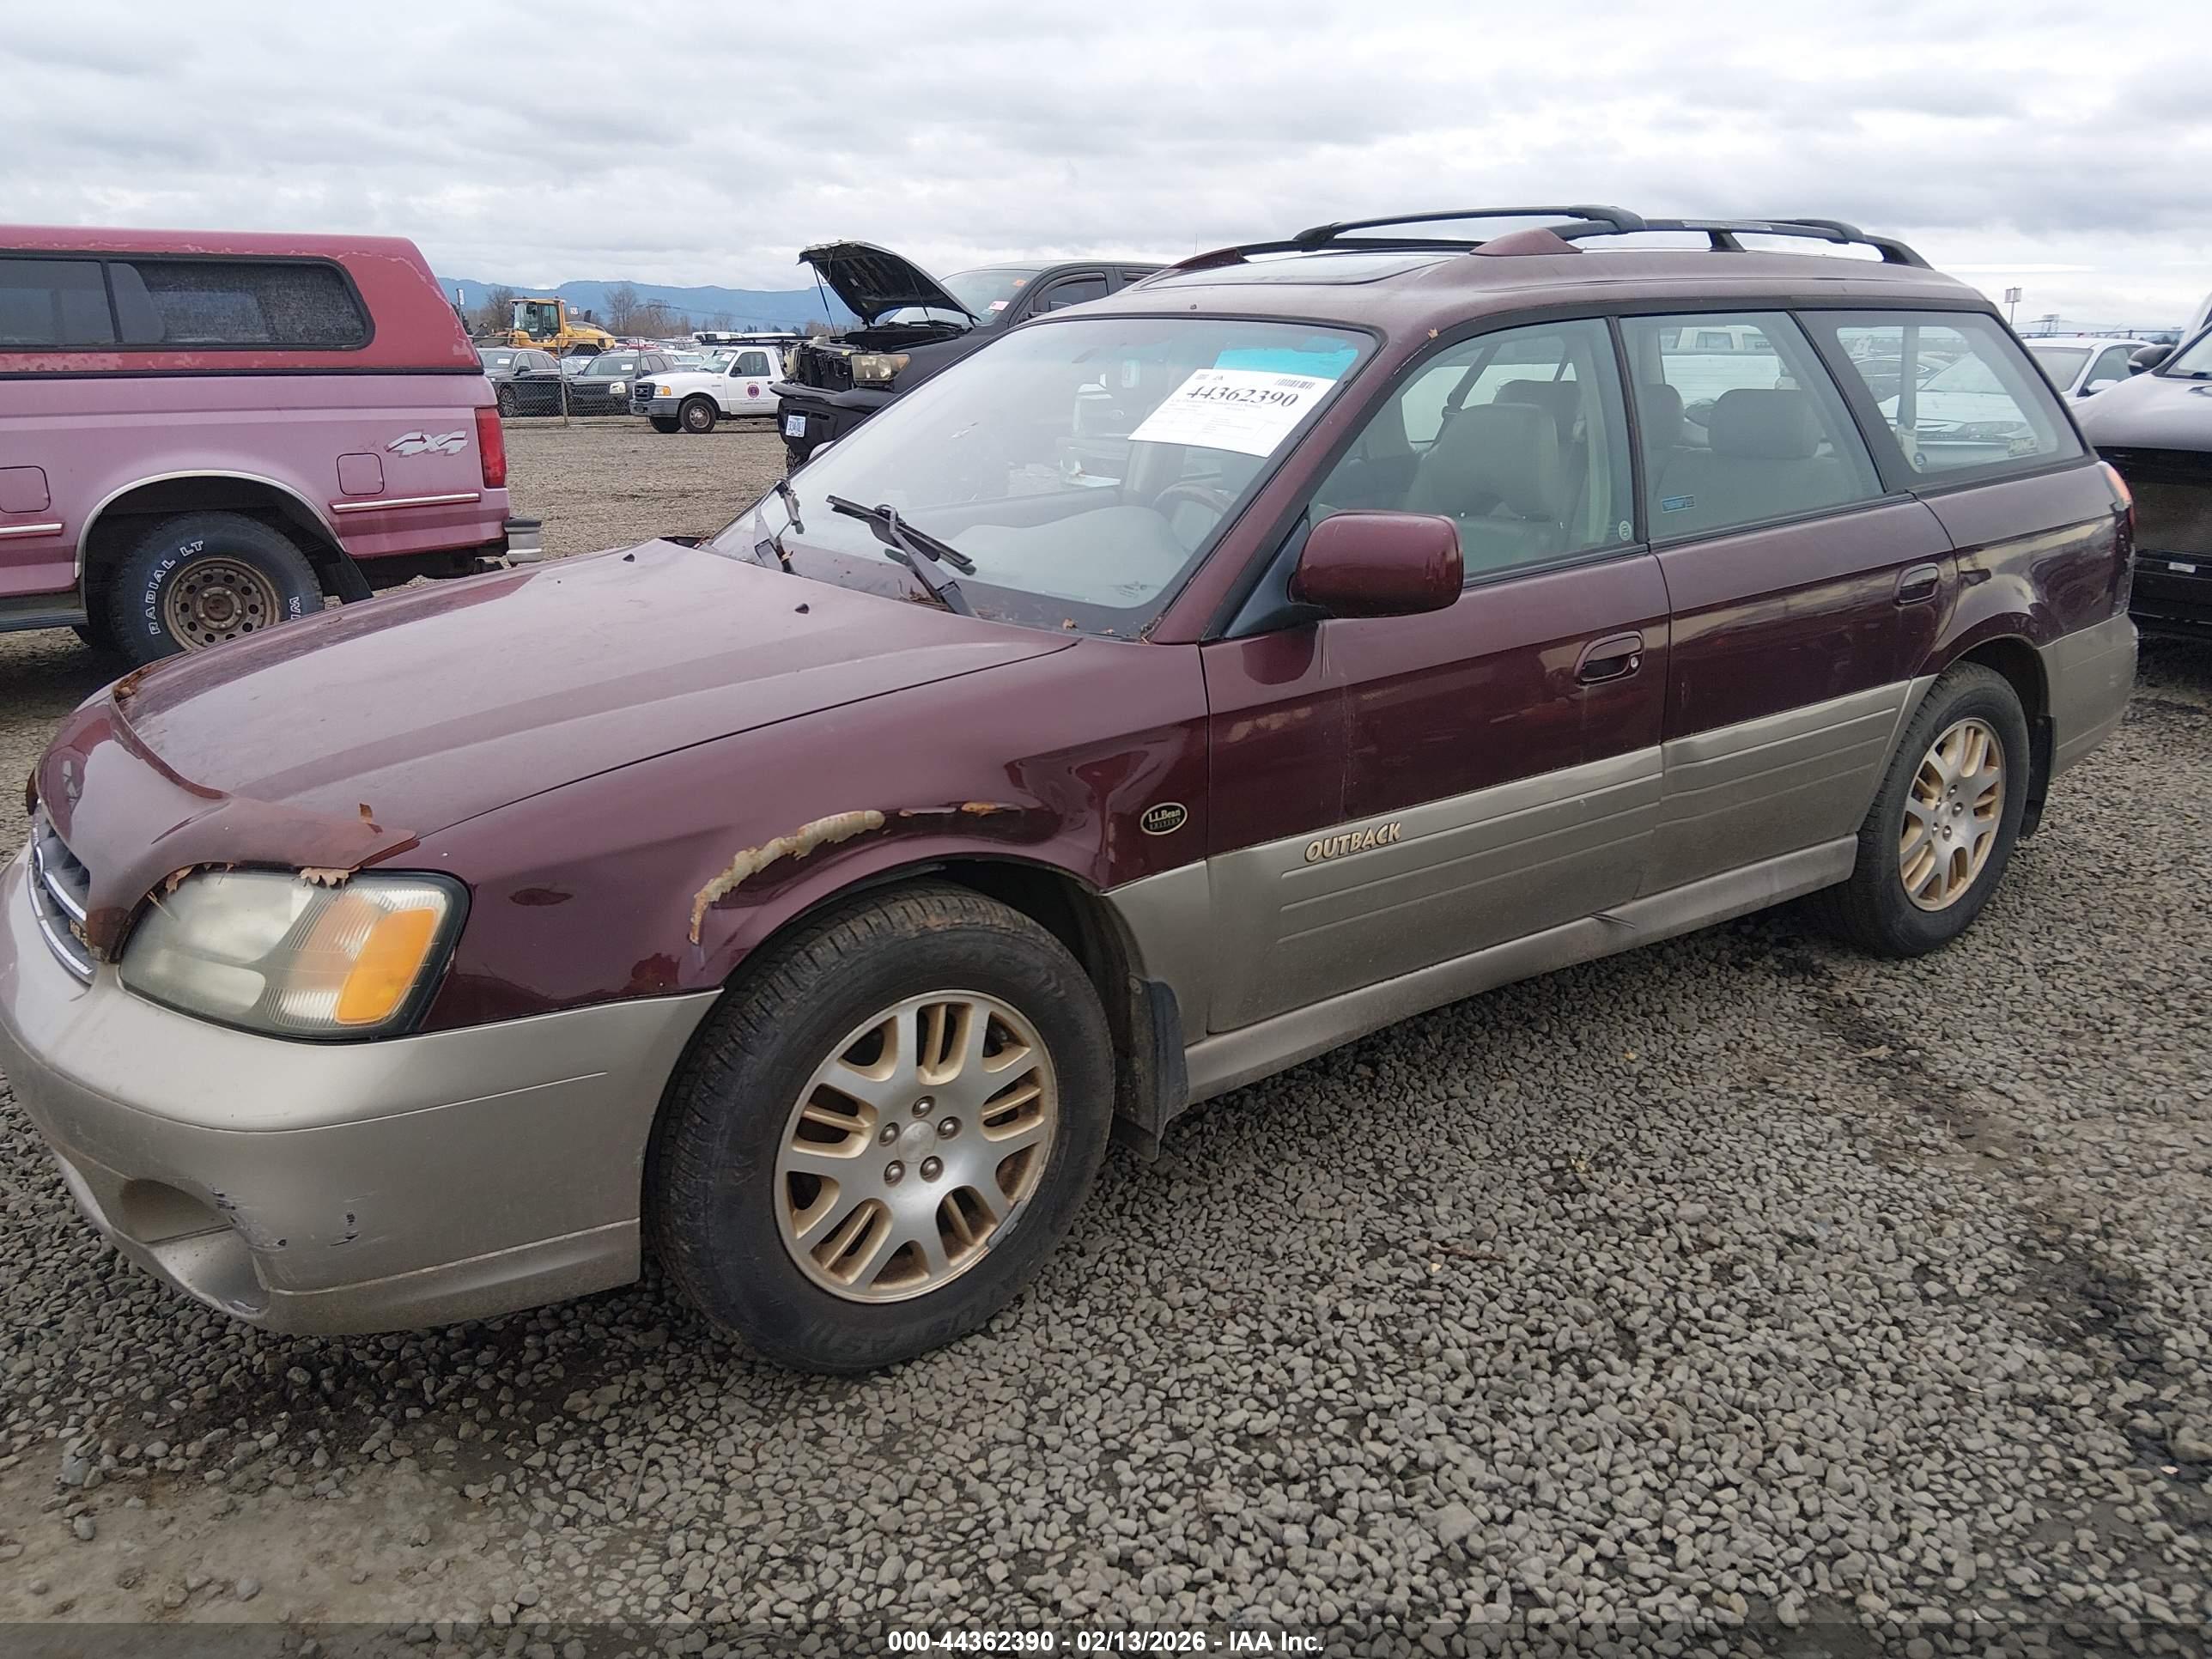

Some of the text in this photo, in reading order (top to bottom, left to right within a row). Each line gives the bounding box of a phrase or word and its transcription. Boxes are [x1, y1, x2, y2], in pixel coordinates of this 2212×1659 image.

[1188, 386, 1298, 407] 44362390
[144, 539, 204, 635] RADIAL LT
[1304, 822, 1402, 863] OUTBACK
